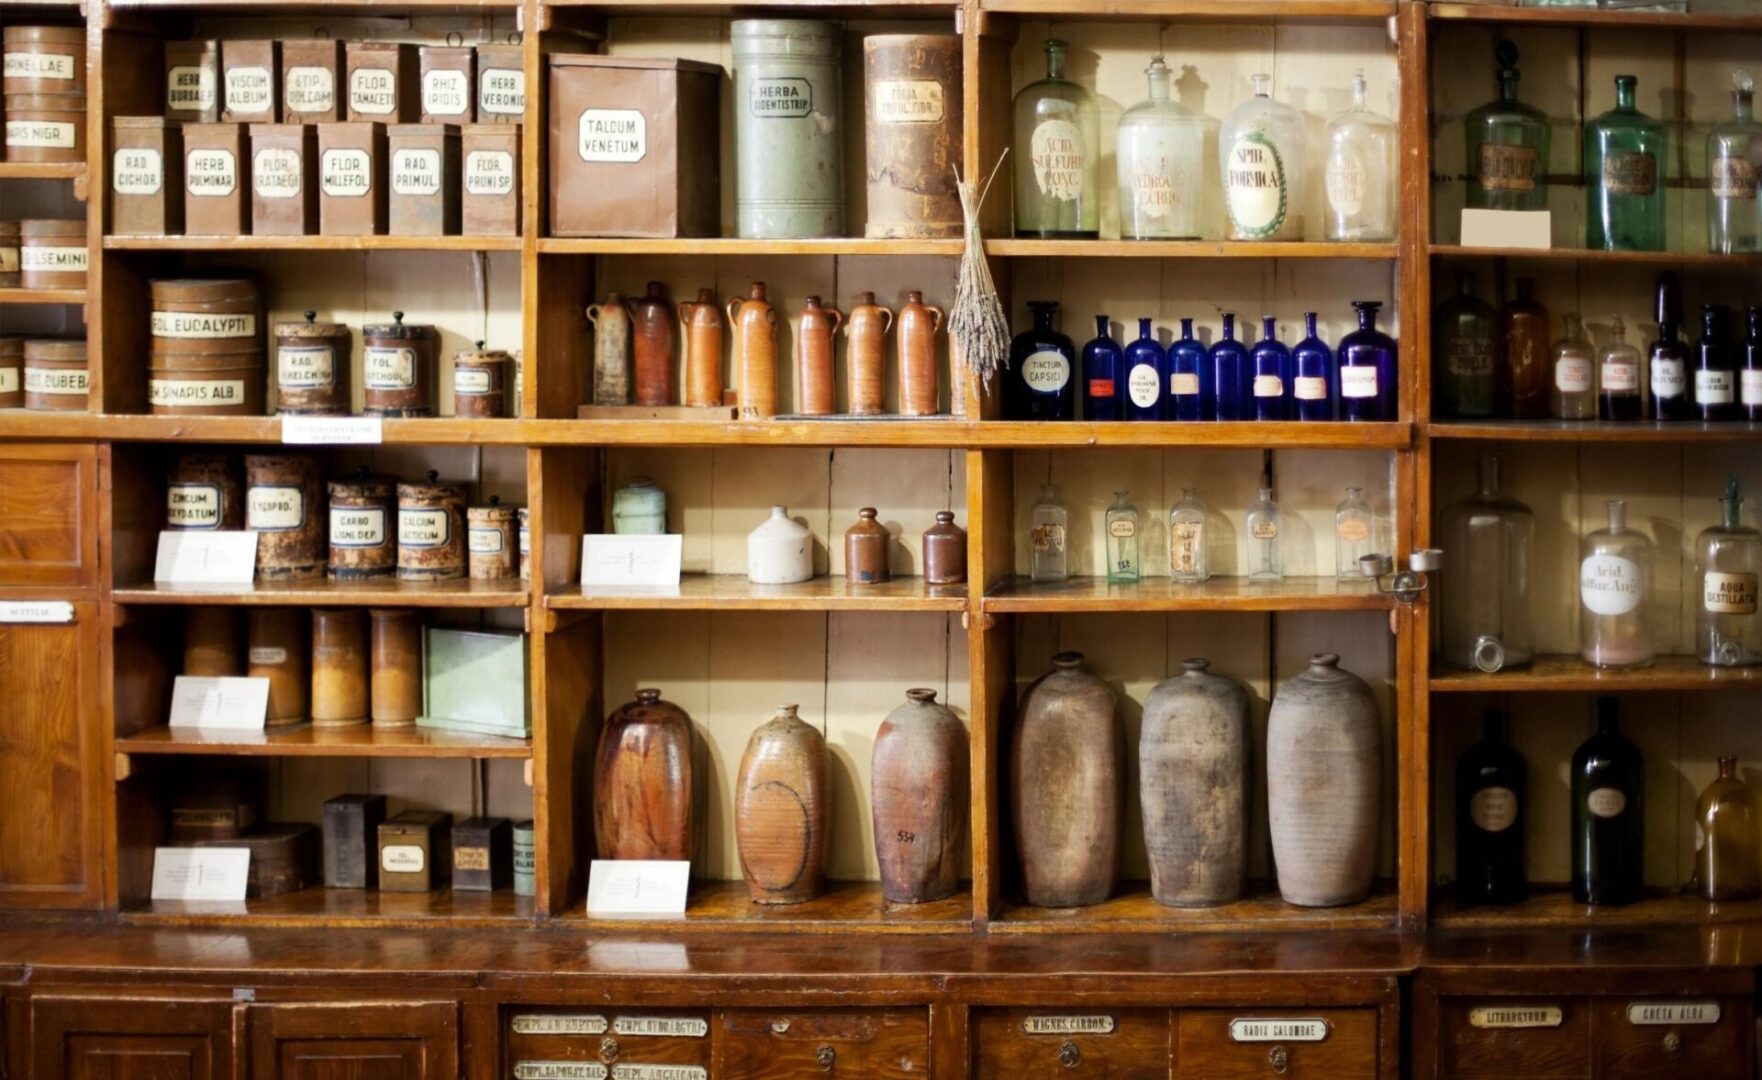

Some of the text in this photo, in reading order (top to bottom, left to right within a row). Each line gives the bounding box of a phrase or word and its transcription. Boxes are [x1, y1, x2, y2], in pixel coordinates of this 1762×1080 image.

[229, 75, 267, 87] VISCUM
[491, 78, 519, 90] HERB.
[229, 91, 267, 103] ALBUM
[760, 86, 799, 97] HERBA
[428, 93, 460, 106] IRIDIS
[587, 119, 636, 134] TALCUM
[584, 139, 639, 153] VENETUM
[332, 158, 363, 170] FLOR.
[405, 158, 429, 170] RAD.
[396, 174, 437, 187] PRIMUL.
[468, 175, 497, 187] PRUNI
[175, 318, 246, 333] EUCALYPTI
[1029, 371, 1061, 382] CAPSICI
[172, 493, 207, 503] ZINCUM
[340, 517, 369, 526] CARBO
[1720, 582, 1745, 592] AQUA
[897, 830, 915, 845] 534
[1643, 1006, 1704, 1020] CRETA ALBA
[1244, 1024, 1267, 1036] RADIX
